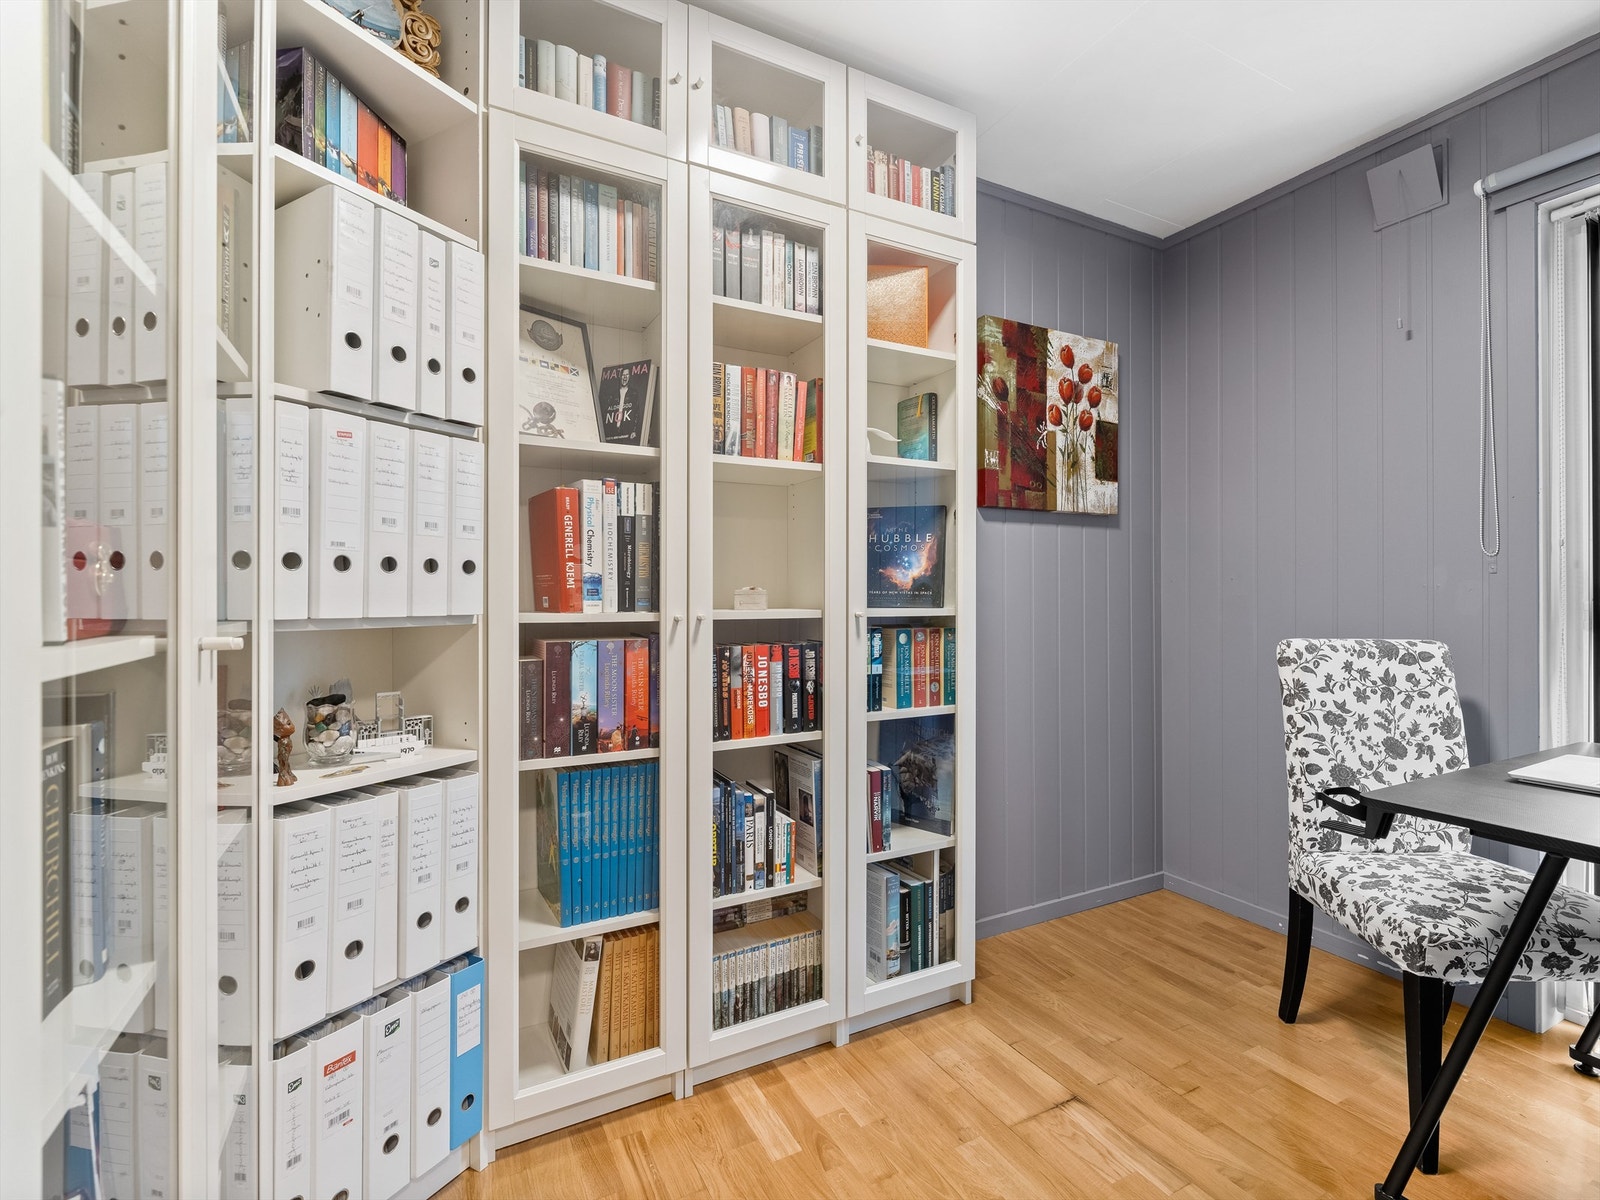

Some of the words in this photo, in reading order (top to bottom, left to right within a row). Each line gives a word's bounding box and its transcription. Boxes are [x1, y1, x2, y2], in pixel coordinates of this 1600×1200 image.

[540, 175, 548, 192] NORA
[550, 178, 559, 196] NORA
[540, 191, 548, 223] ROBERTS
[550, 194, 559, 225] ROBERTS
[602, 363, 649, 381] MATMA
[713, 363, 722, 376] DAN
[713, 376, 722, 398] BROWN
[605, 486, 615, 494] ISE
[584, 496, 595, 528] Physical
[564, 514, 574, 559] GENERELL
[868, 533, 933, 543] HUBBLE
[584, 529, 595, 568] Chemistry
[874, 544, 926, 552] COSMOS
[638, 541, 650, 579] CHEMISTRY
[565, 562, 575, 589] KJEMI
[746, 650, 754, 660] JO
[788, 647, 800, 657] JO
[805, 649, 815, 659] JO
[873, 633, 881, 658] Pullman
[721, 659, 729, 671] JO
[757, 655, 768, 668] JO
[788, 657, 800, 679] NESBØ
[805, 658, 816, 681] NESBØ
[603, 662, 611, 690] Lucinda
[603, 691, 611, 709] Riley
[630, 689, 638, 707] Riley
[757, 670, 768, 708] NESBØ
[400, 746, 415, 754] 1970
[745, 819, 754, 849] PARIS
[46, 783, 60, 977] CHURCHILL
[604, 953, 612, 973] MITT
[614, 952, 622, 971] MITT
[579, 980, 588, 1015] HISTORIE
[601, 976, 611, 1036] SKATTKAMMER
[613, 974, 622, 1033] SKATTKAMMER
[622, 972, 630, 1031] SKATTKAMMER
[630, 969, 638, 1028] SKATTKAMMER
[326, 1055, 353, 1074] Bantex
